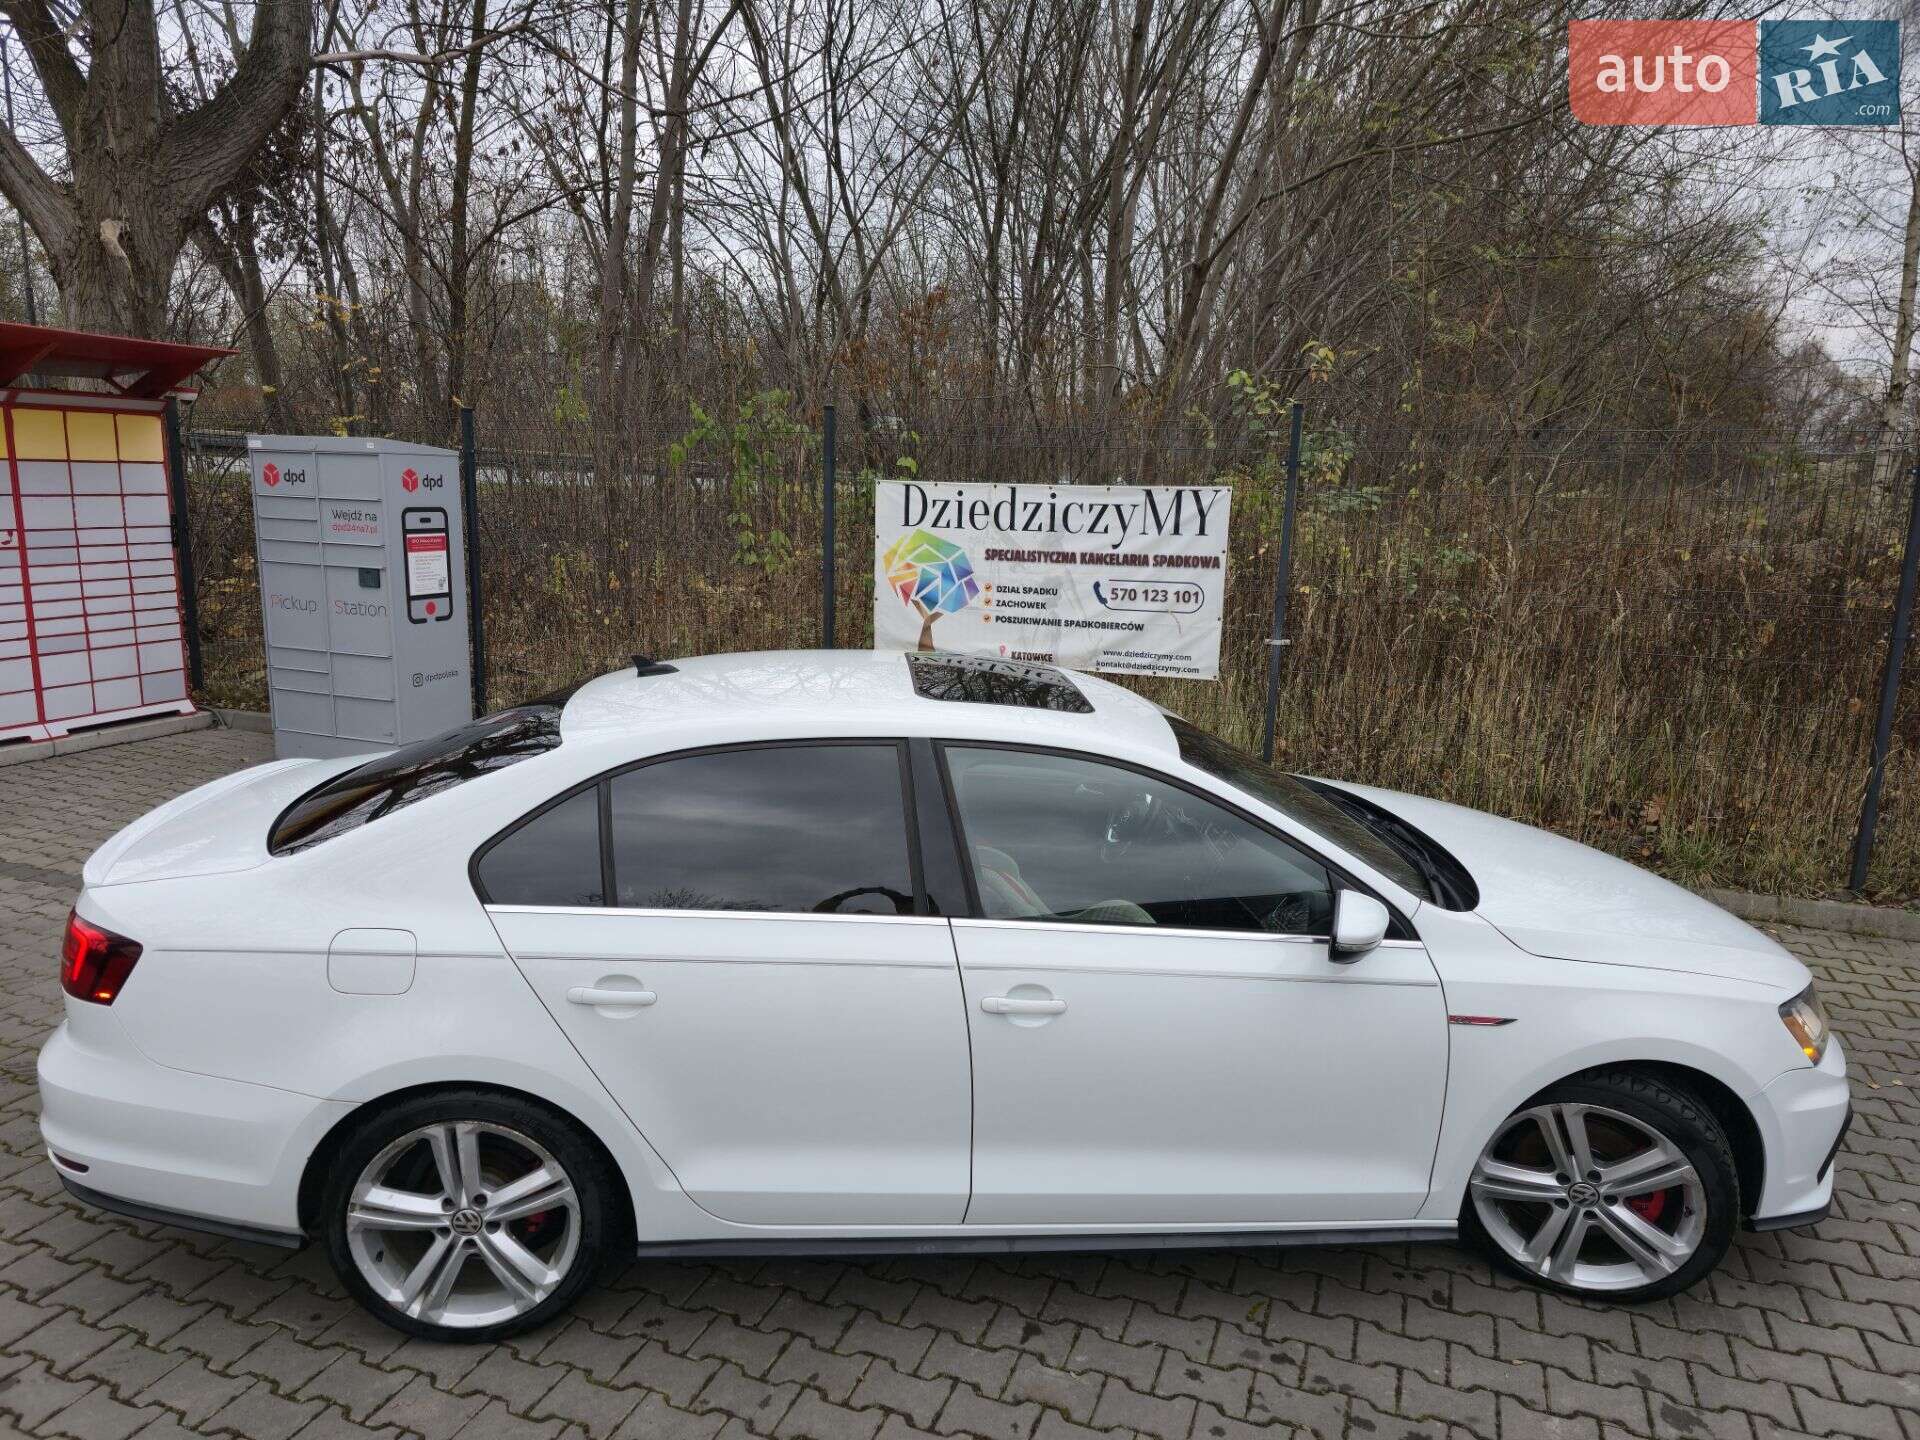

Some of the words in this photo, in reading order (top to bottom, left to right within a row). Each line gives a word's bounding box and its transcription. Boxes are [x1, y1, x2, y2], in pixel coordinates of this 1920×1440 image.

[283, 468, 305, 485] dpd
[422, 473, 443, 490] dpd
[364, 512, 377, 521] na
[901, 484, 1220, 549] DziedziczyMY
[984, 548, 1077, 564] SPECJALISTYCZNA
[1080, 551, 1150, 567] KANCELARIA
[1152, 554, 1221, 569] SPADKOWA
[996, 585, 1020, 594] DZIAŁ
[1022, 586, 1058, 596] SPADKU
[1110, 587, 1137, 601] 570
[1141, 588, 1168, 603] 123
[1173, 590, 1200, 604] 101
[270, 594, 318, 612] Pickup
[334, 600, 387, 616] Station
[996, 599, 1047, 610] ZACHOWEK
[995, 615, 1062, 627] POSZUKIWANIE
[1064, 618, 1145, 631] SPADKOBIERCÓW
[1010, 651, 1054, 662] KATOWICE
[1103, 649, 1192, 662] www.dziedziczymy.com
